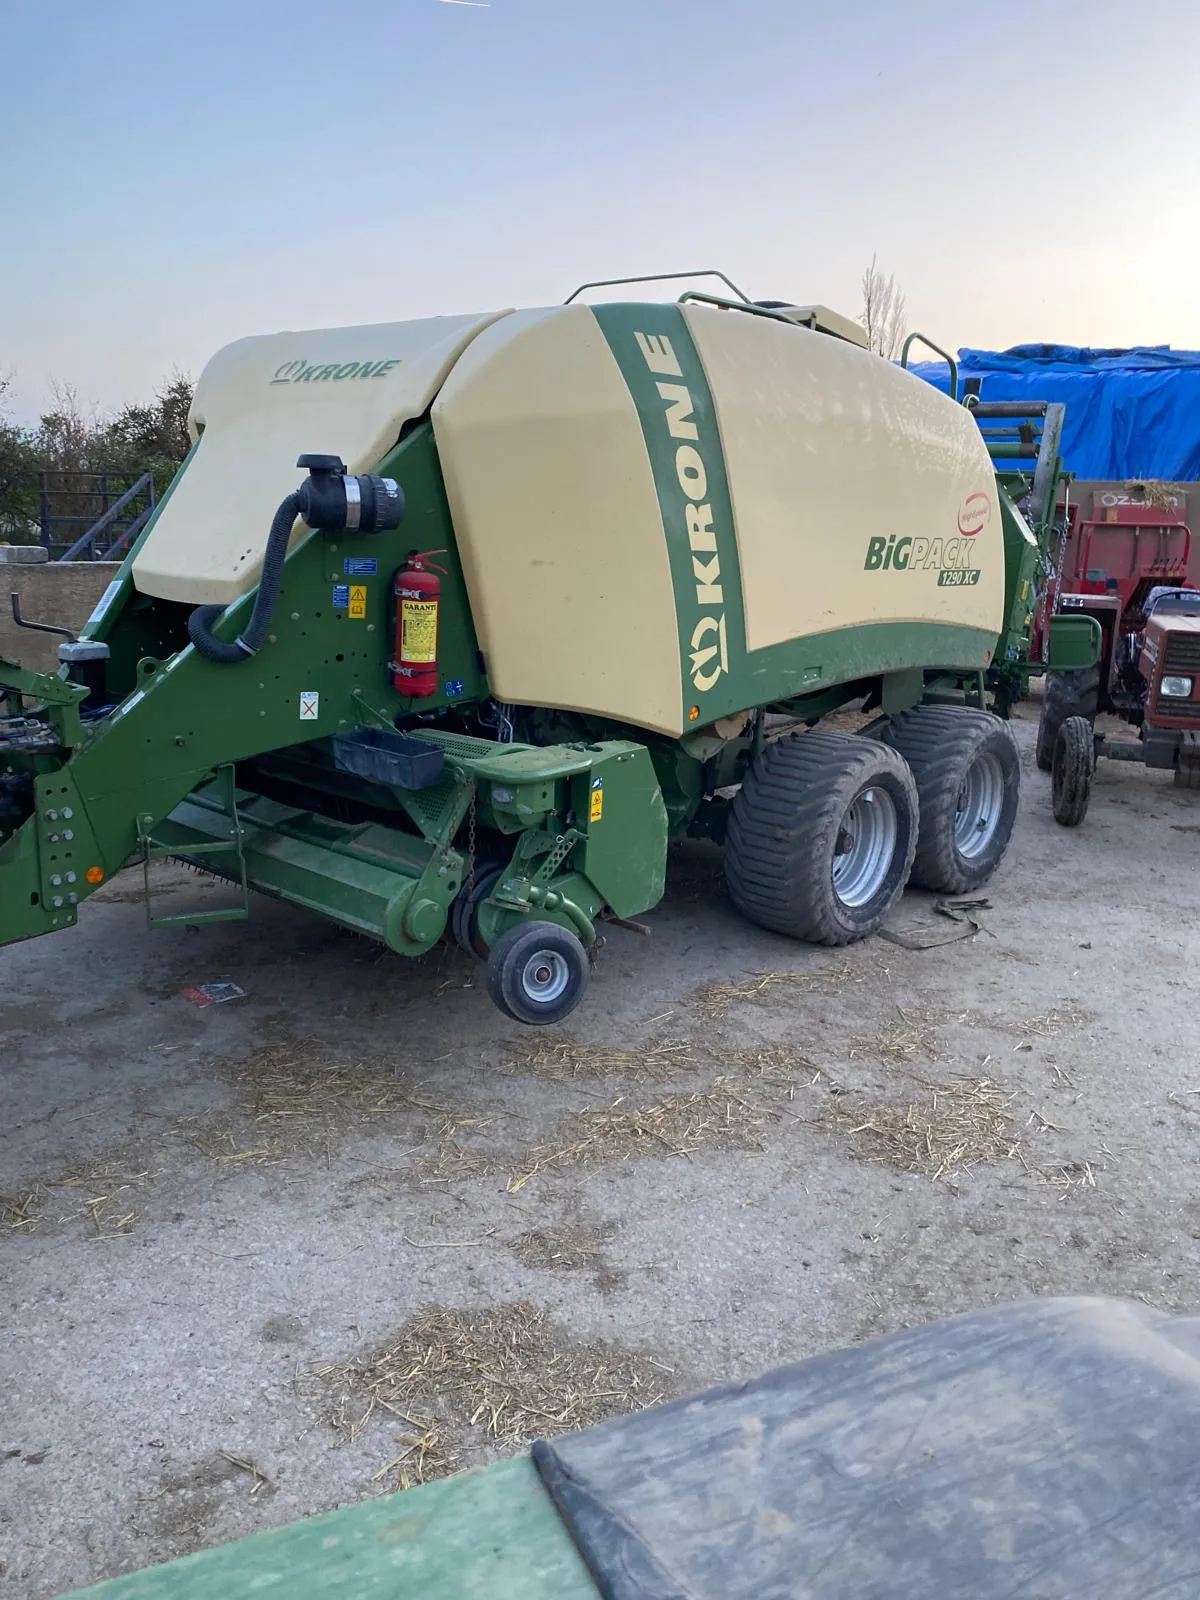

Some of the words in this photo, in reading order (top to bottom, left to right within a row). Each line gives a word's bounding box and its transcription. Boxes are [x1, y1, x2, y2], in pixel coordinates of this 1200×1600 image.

[294, 359, 402, 382] KRONE
[633, 331, 724, 605] KRONE
[942, 571, 962, 585] 1290
[963, 571, 977, 585] XC
